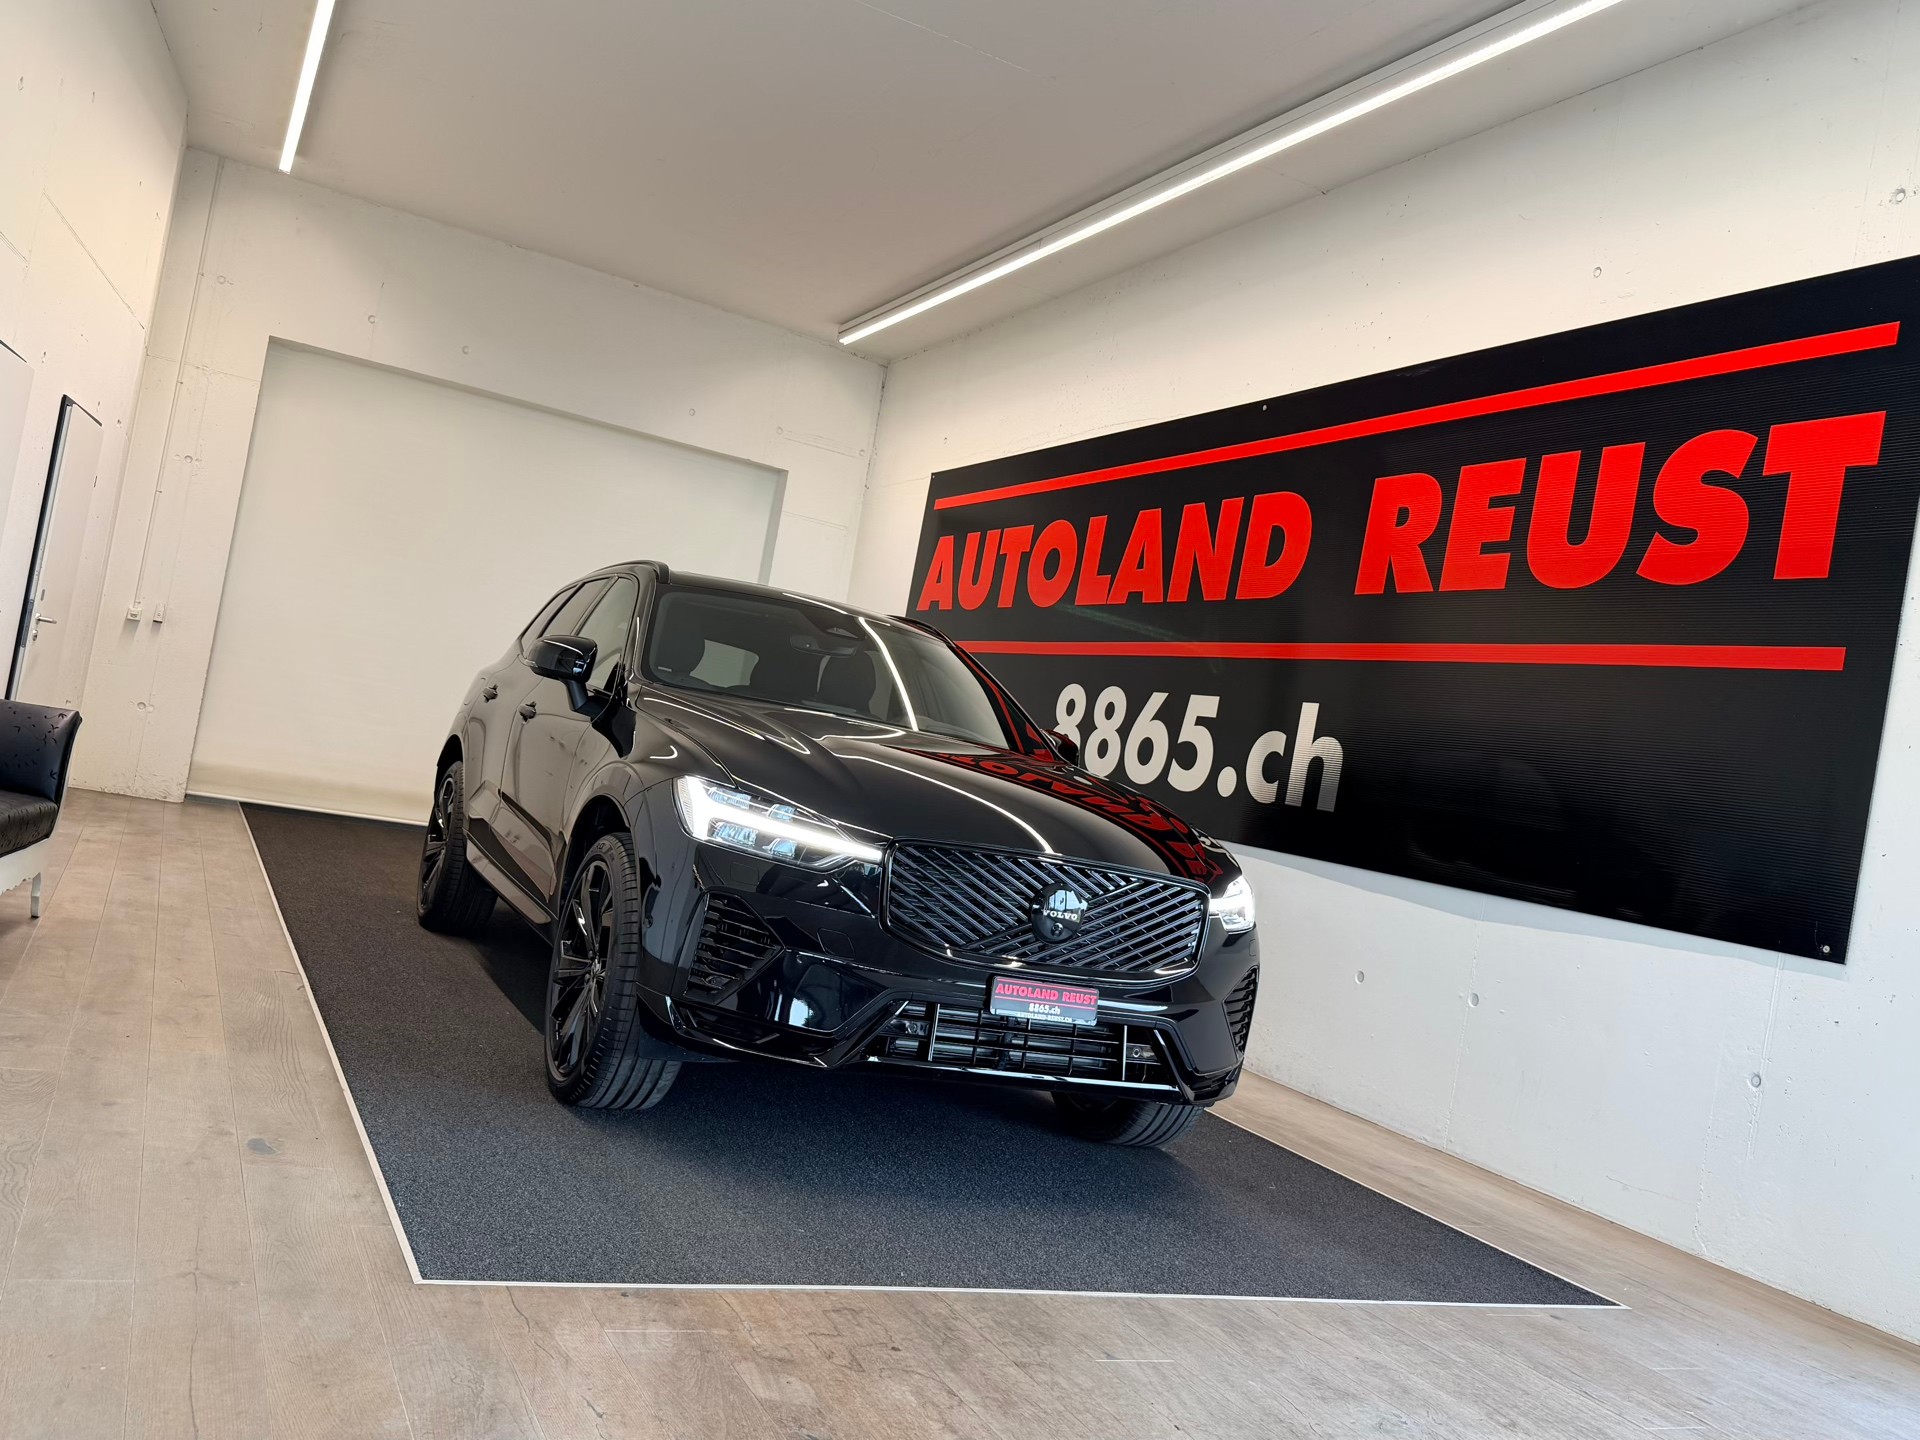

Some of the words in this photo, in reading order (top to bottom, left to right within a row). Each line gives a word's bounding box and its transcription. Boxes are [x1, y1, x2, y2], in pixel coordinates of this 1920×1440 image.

[916, 491, 1313, 611] AUTOLAND
[1354, 410, 1887, 595] REUST
[1053, 683, 1344, 812] 8865.ch
[1042, 909, 1078, 921] VOLVO
[995, 983, 1059, 1000] AUTOLAND
[1062, 991, 1097, 1005] REUST
[1028, 1002, 1061, 1015] 8865.ch
